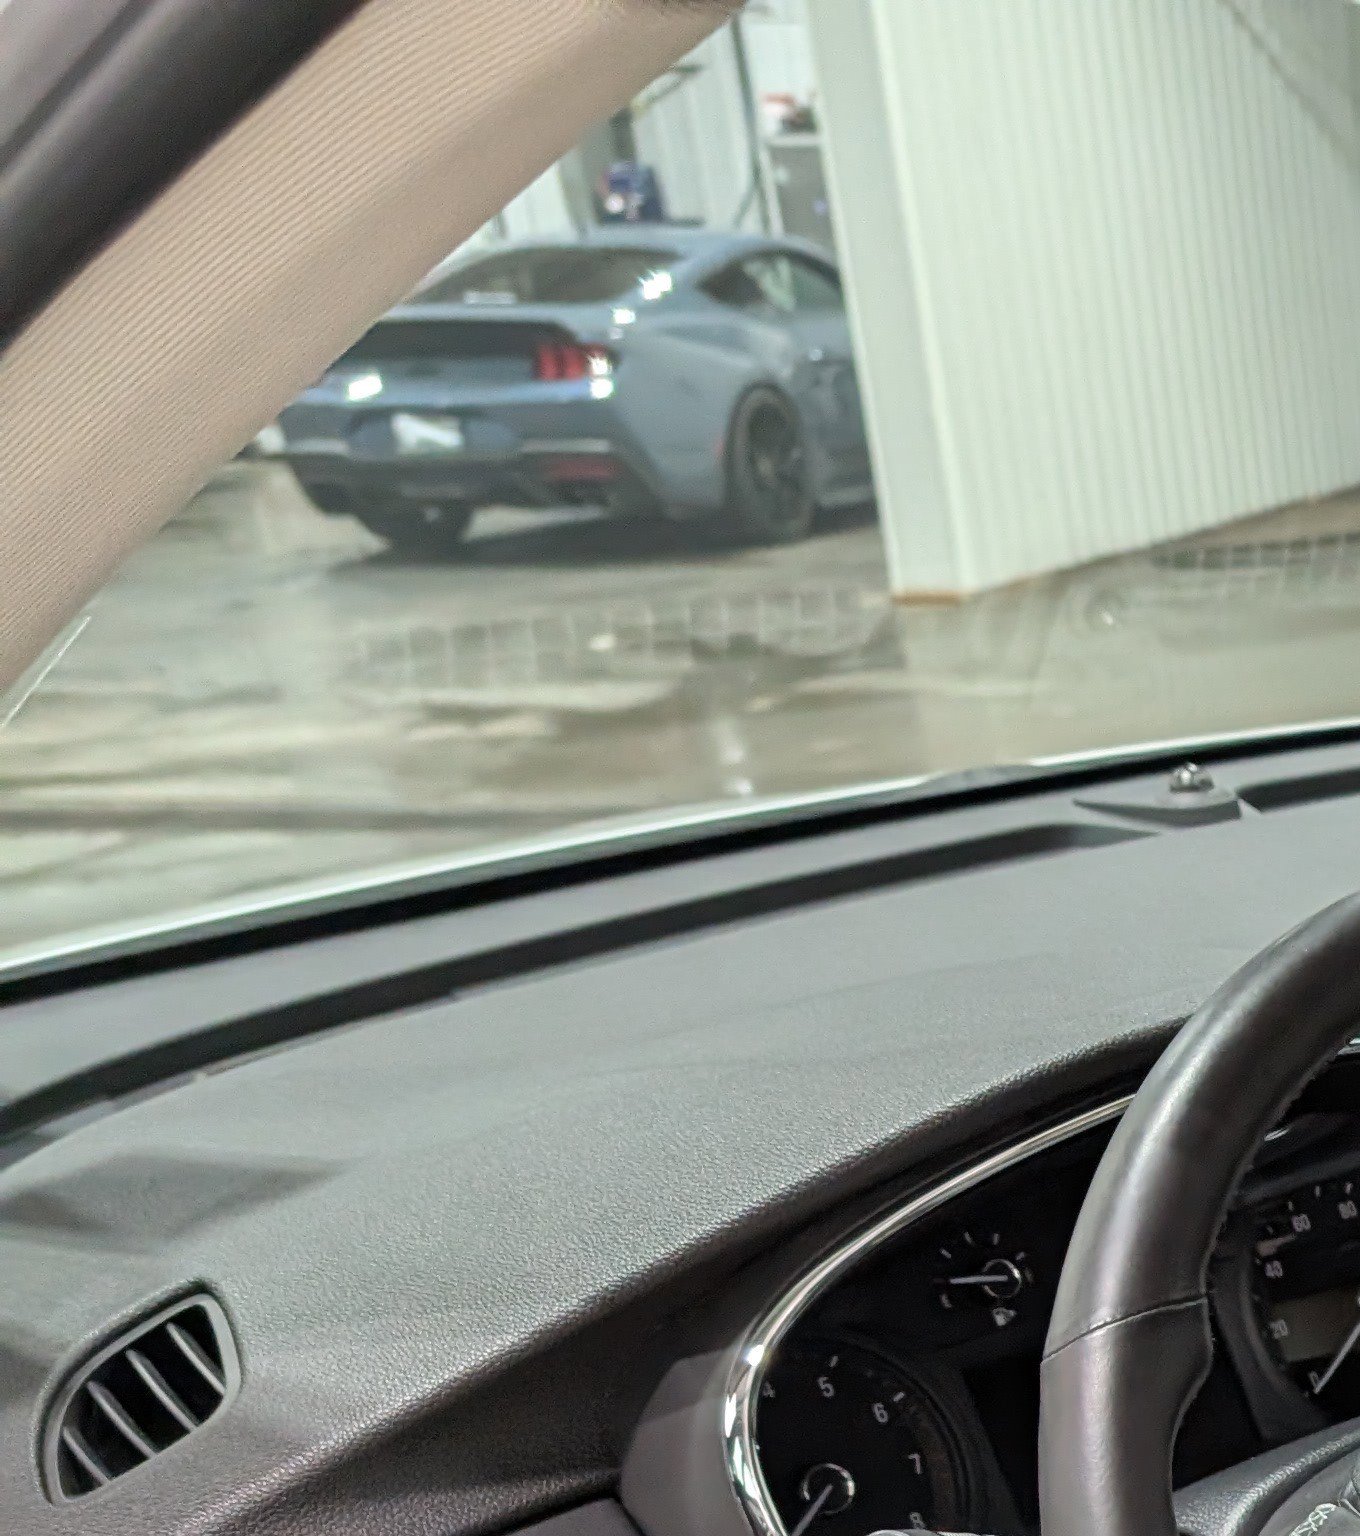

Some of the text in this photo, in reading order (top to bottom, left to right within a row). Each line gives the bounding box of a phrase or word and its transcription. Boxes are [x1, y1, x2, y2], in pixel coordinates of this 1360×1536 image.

[762, 1380, 776, 1398] 4
[818, 1376, 835, 1398] 5
[872, 1402, 889, 1423] 6
[907, 1452, 922, 1475] 7
